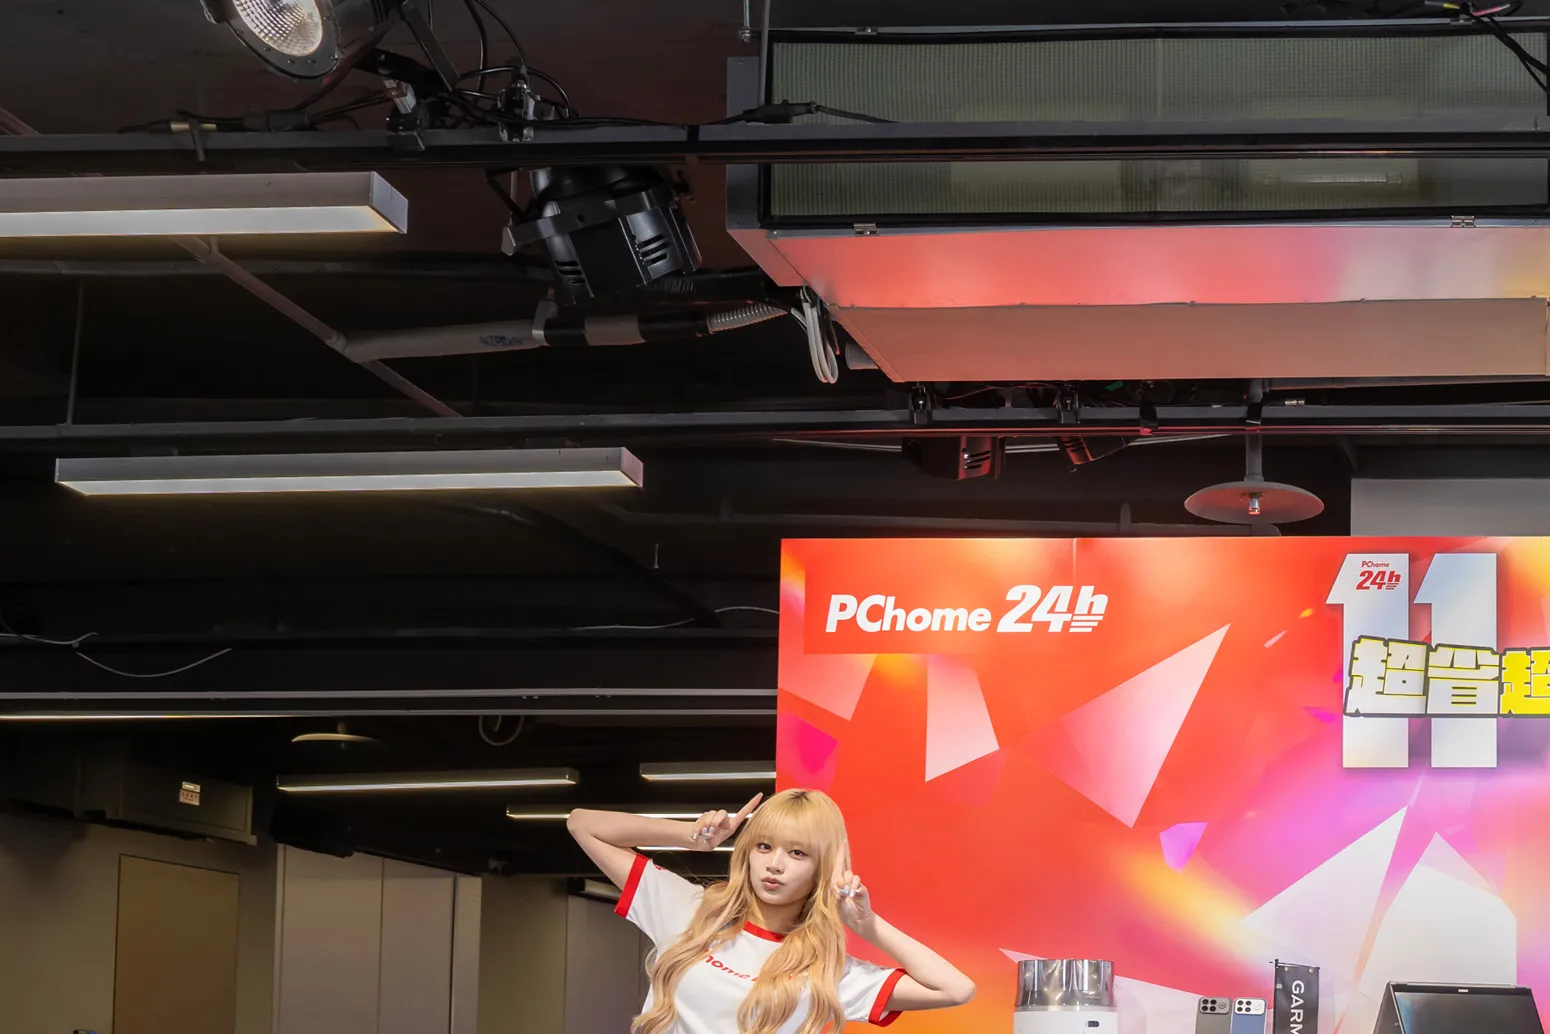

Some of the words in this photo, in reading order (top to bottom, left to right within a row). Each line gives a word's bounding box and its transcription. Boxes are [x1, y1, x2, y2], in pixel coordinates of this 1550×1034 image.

[1356, 570, 1401, 590] 24h
[825, 594, 992, 632] PChome
[997, 585, 1109, 632] 24h
